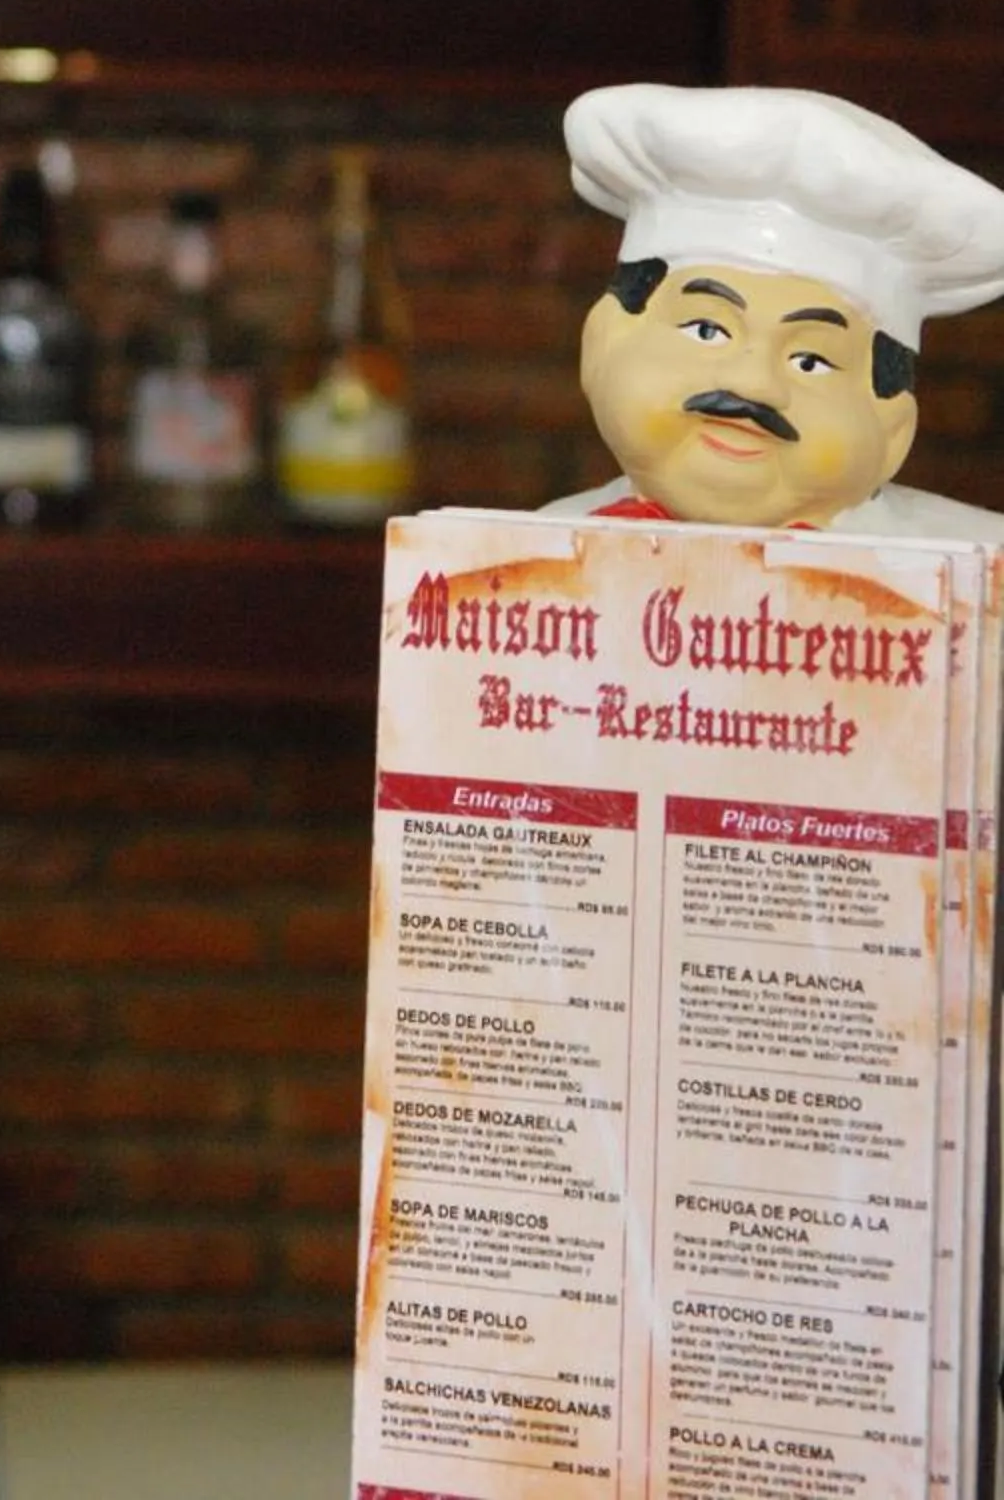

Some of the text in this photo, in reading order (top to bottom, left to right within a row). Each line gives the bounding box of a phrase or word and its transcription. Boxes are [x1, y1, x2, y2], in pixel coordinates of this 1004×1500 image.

[402, 572, 932, 687] Maison Gautreaux
[453, 786, 553, 813] Entradas
[404, 818, 592, 848] ENSALADA GAUTREAUX
[720, 809, 892, 845] Platos Fuertes
[684, 843, 872, 875] FILETE AL CHAMPIÑON
[400, 912, 548, 939] SOPA DE CEBOLLA
[680, 962, 866, 995] FILETE A LA PLANCHA
[398, 1008, 536, 1034] DEDOS DE POLLO
[678, 1079, 862, 1112] COSTILLAS DE CERDO
[394, 1100, 578, 1133] DEDOS DE MOZARELLA
[390, 1199, 548, 1231] SOPA DE MARISCOS
[676, 1194, 890, 1233] PECHUGA DE POLLO A LA
[730, 1222, 810, 1245] PLANCHA
[386, 1300, 528, 1331] ALITAS DE POLLO
[672, 1300, 834, 1334] CARTOCHO DE RES
[384, 1377, 486, 1405] SALCHICHAS
[490, 1390, 612, 1420] VENEZOLANAS
[670, 1425, 834, 1463] POLLO A LA CREMA
